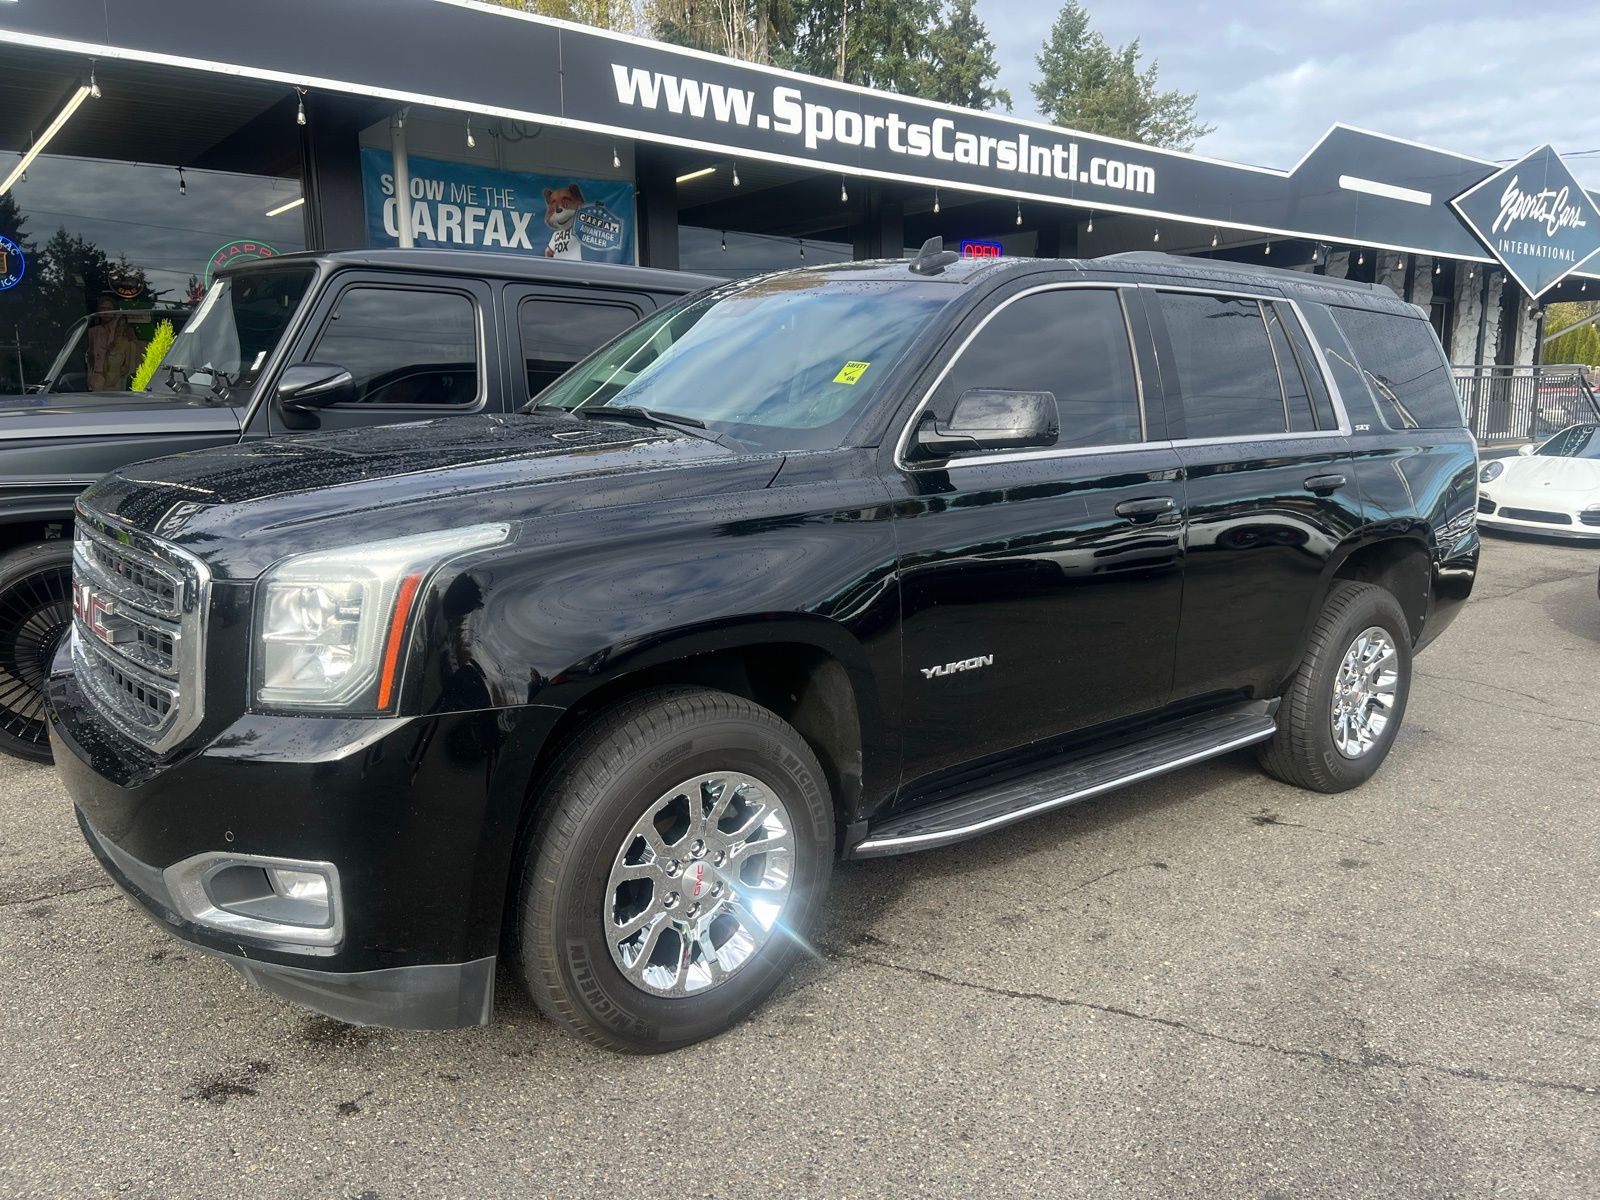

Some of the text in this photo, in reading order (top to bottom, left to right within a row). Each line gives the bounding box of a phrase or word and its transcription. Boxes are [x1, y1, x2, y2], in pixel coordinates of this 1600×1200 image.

[611, 63, 1156, 195] www.SportsCarsIntl.com
[380, 173, 516, 209] SOW ME THE
[1491, 174, 1587, 238] Sports Cars
[383, 197, 534, 250] CARFAX
[554, 228, 571, 242] CAR
[579, 213, 620, 234] CARFAX
[580, 224, 615, 241] ADVANTAGE
[554, 241, 569, 253] FOX
[581, 234, 607, 248] DEALER
[963, 244, 1000, 258] OPEN
[1498, 239, 1576, 263] INTERNATIONAL
[920, 654, 994, 679] YUKON
[693, 864, 704, 897] GMC
[569, 943, 634, 1031] MICHELIN
